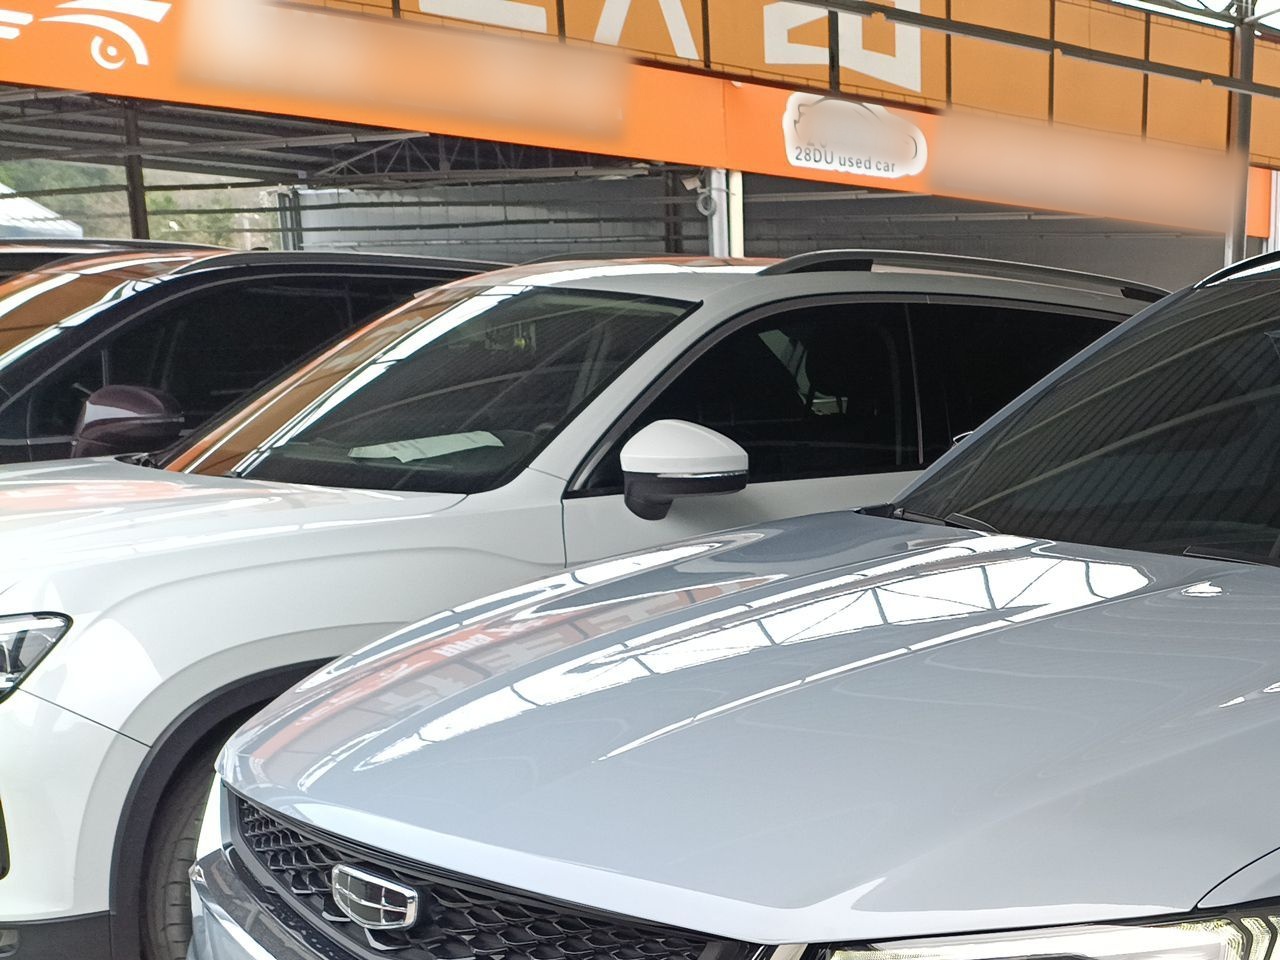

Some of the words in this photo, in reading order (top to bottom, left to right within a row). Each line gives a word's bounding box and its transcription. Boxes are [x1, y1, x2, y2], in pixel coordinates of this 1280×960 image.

[795, 146, 834, 165] 28DU
[838, 155, 873, 170] used
[875, 160, 896, 173] car
